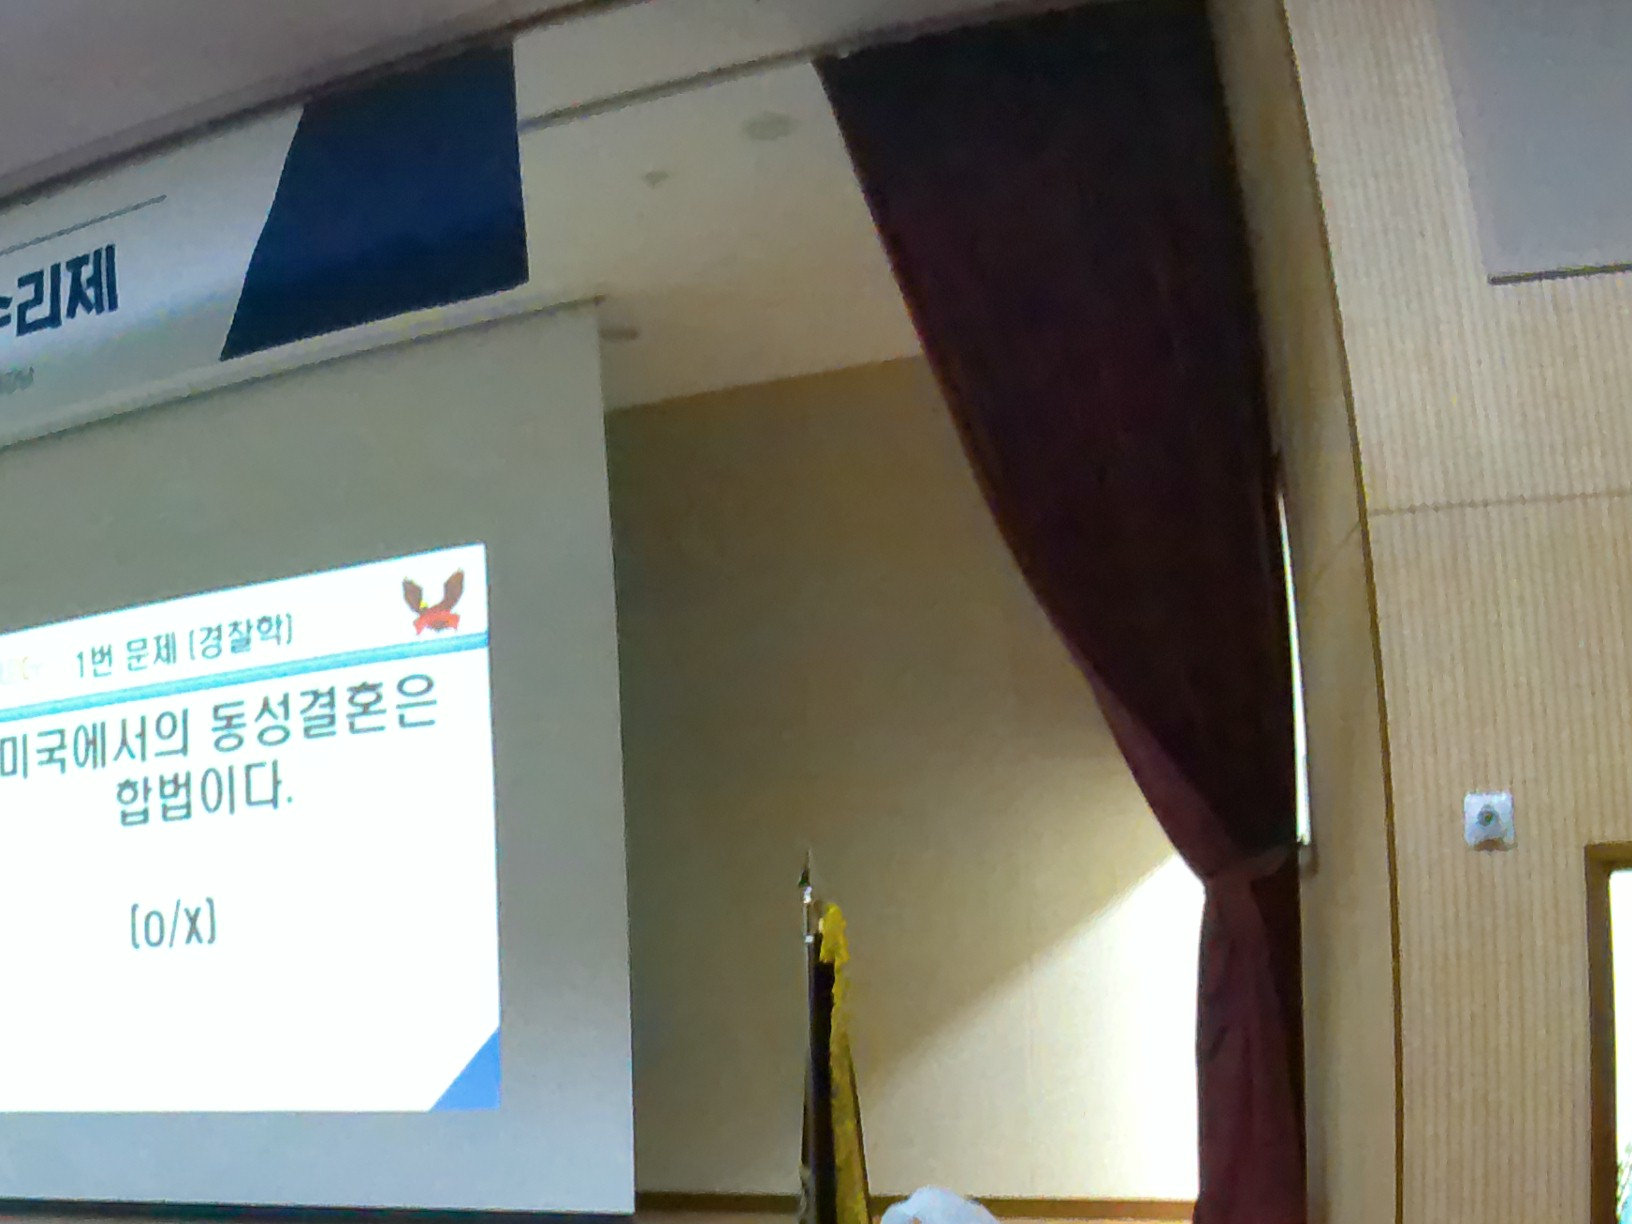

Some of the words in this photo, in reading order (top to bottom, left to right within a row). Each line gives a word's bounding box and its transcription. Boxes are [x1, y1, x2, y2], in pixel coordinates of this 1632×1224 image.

[76, 644, 113, 678] 1번
[126, 631, 177, 672] 문제
[210, 672, 438, 754] 동성결혼은
[116, 759, 294, 827] 합법이다.
